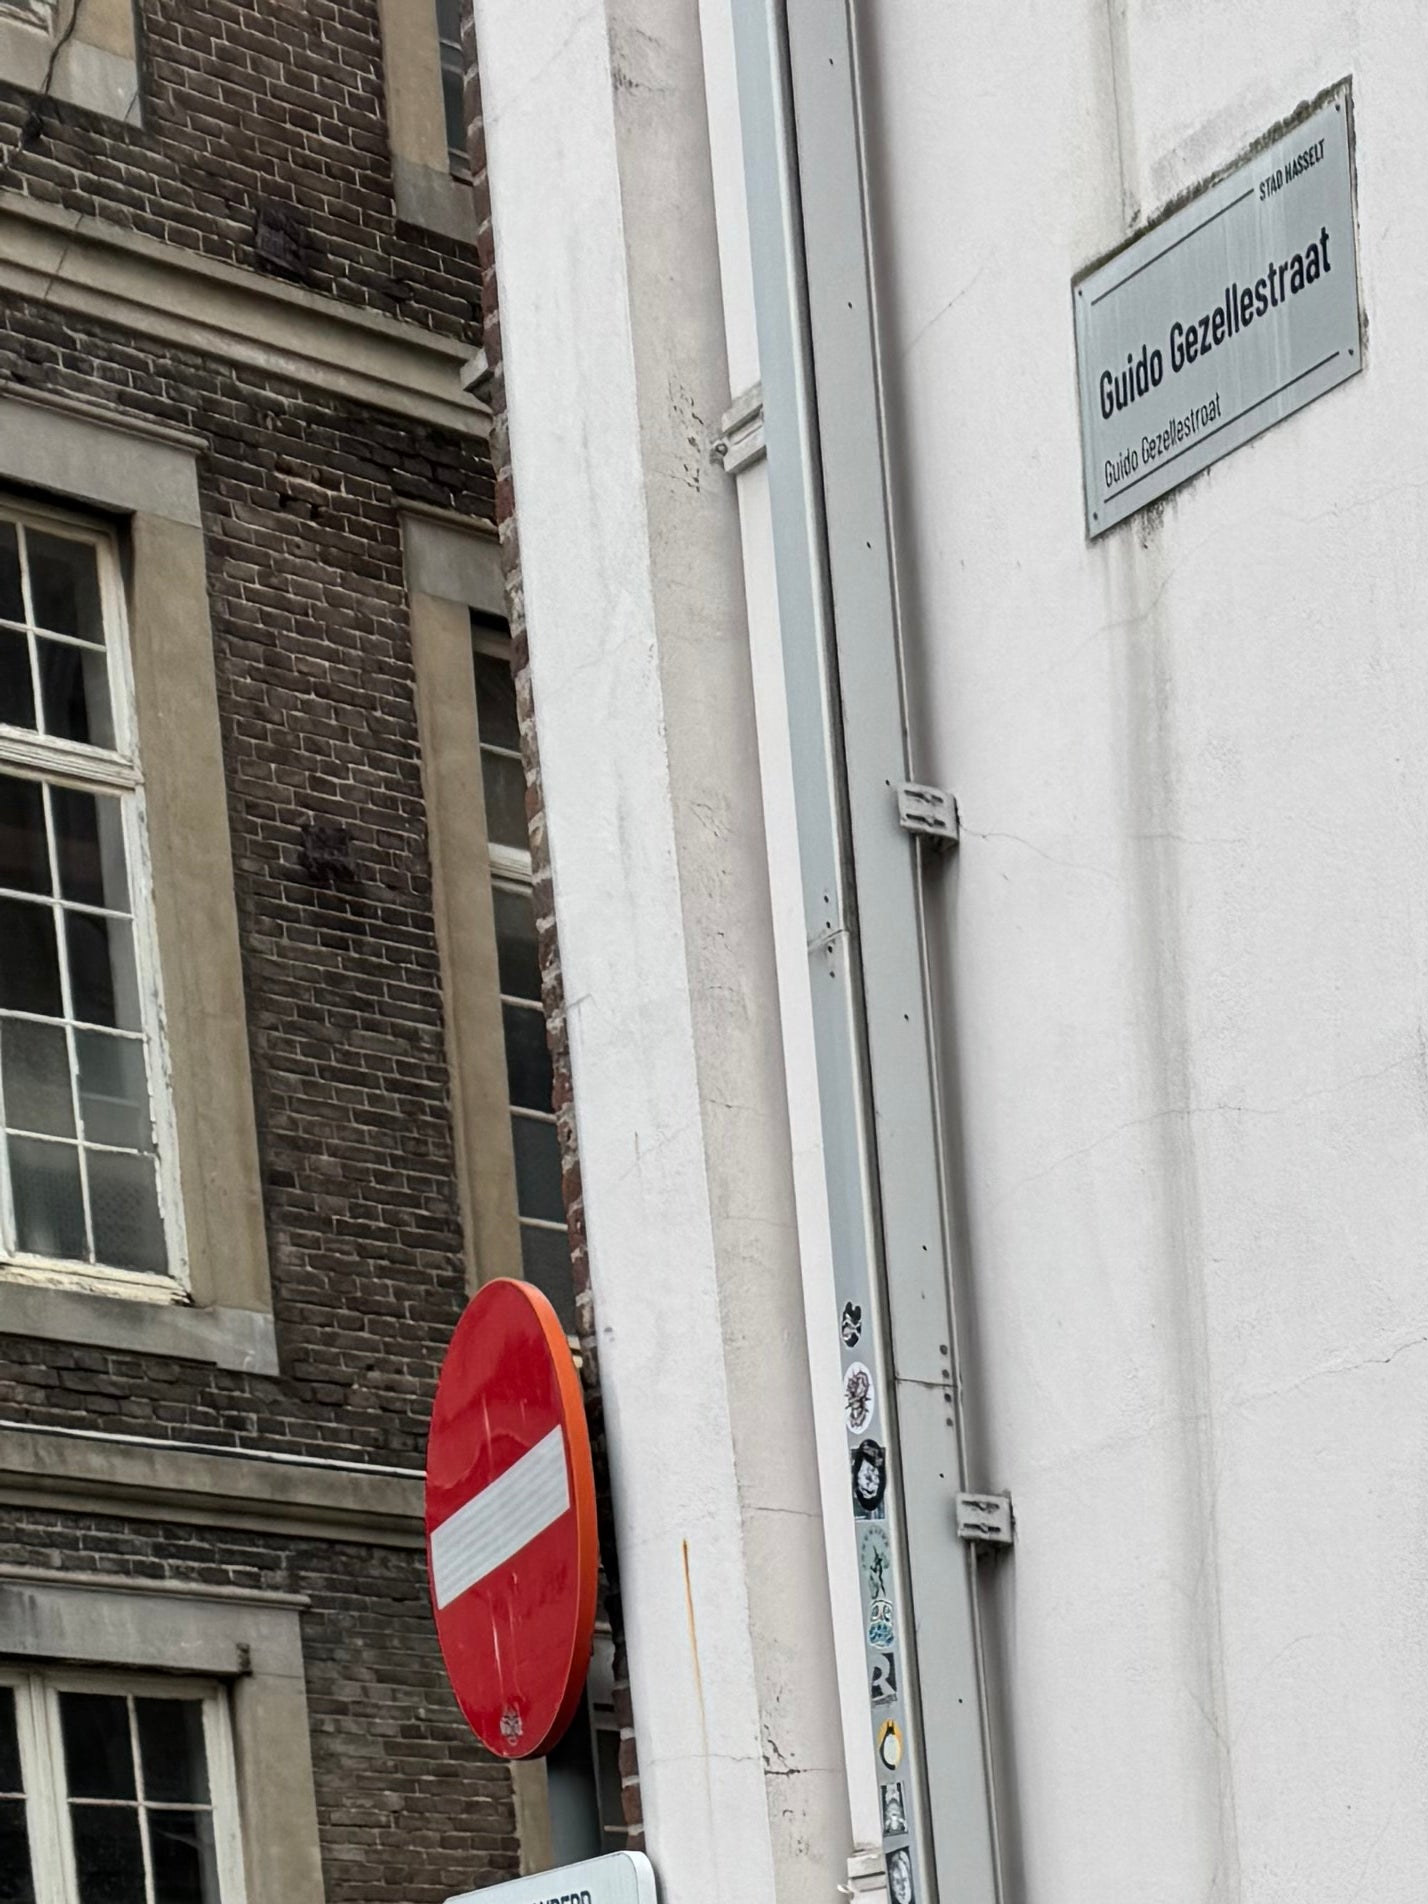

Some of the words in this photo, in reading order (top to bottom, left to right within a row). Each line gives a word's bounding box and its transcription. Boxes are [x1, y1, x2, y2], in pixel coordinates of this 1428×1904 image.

[1259, 169, 1283, 202] STAD
[1284, 138, 1325, 184] HASSELT
[1100, 343, 1163, 420] Guido
[1169, 226, 1332, 374] Gezellestraat
[1104, 448, 1139, 488] Guido
[1141, 391, 1222, 464] Gezellestroat
